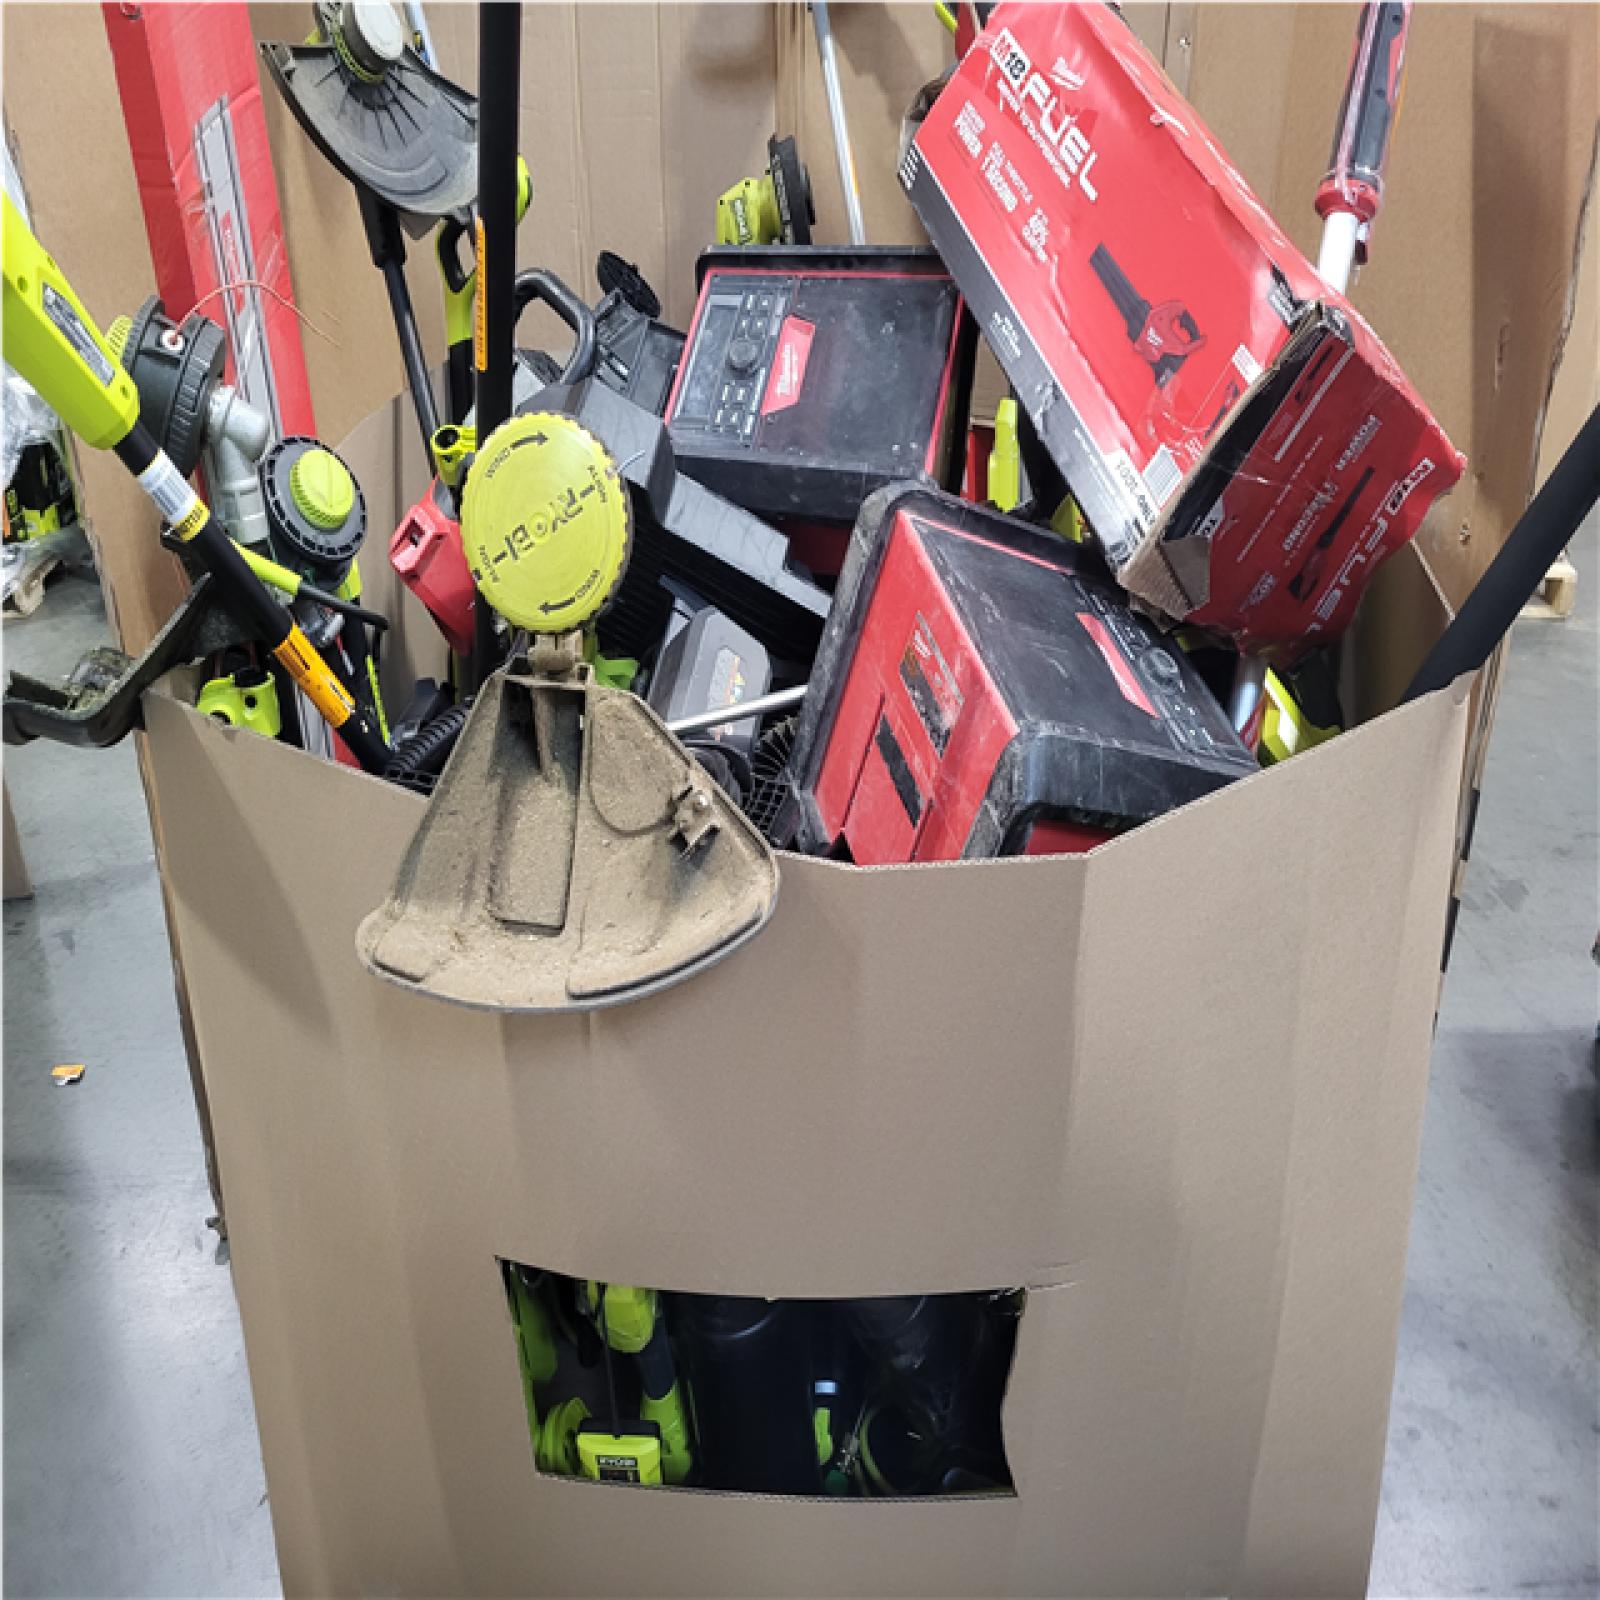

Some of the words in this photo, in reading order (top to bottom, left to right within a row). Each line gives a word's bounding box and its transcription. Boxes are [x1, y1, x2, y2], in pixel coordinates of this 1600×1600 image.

[994, 31, 1027, 82] M18
[1021, 72, 1098, 201] FUEL
[504, 487, 584, 561] RYOBI
